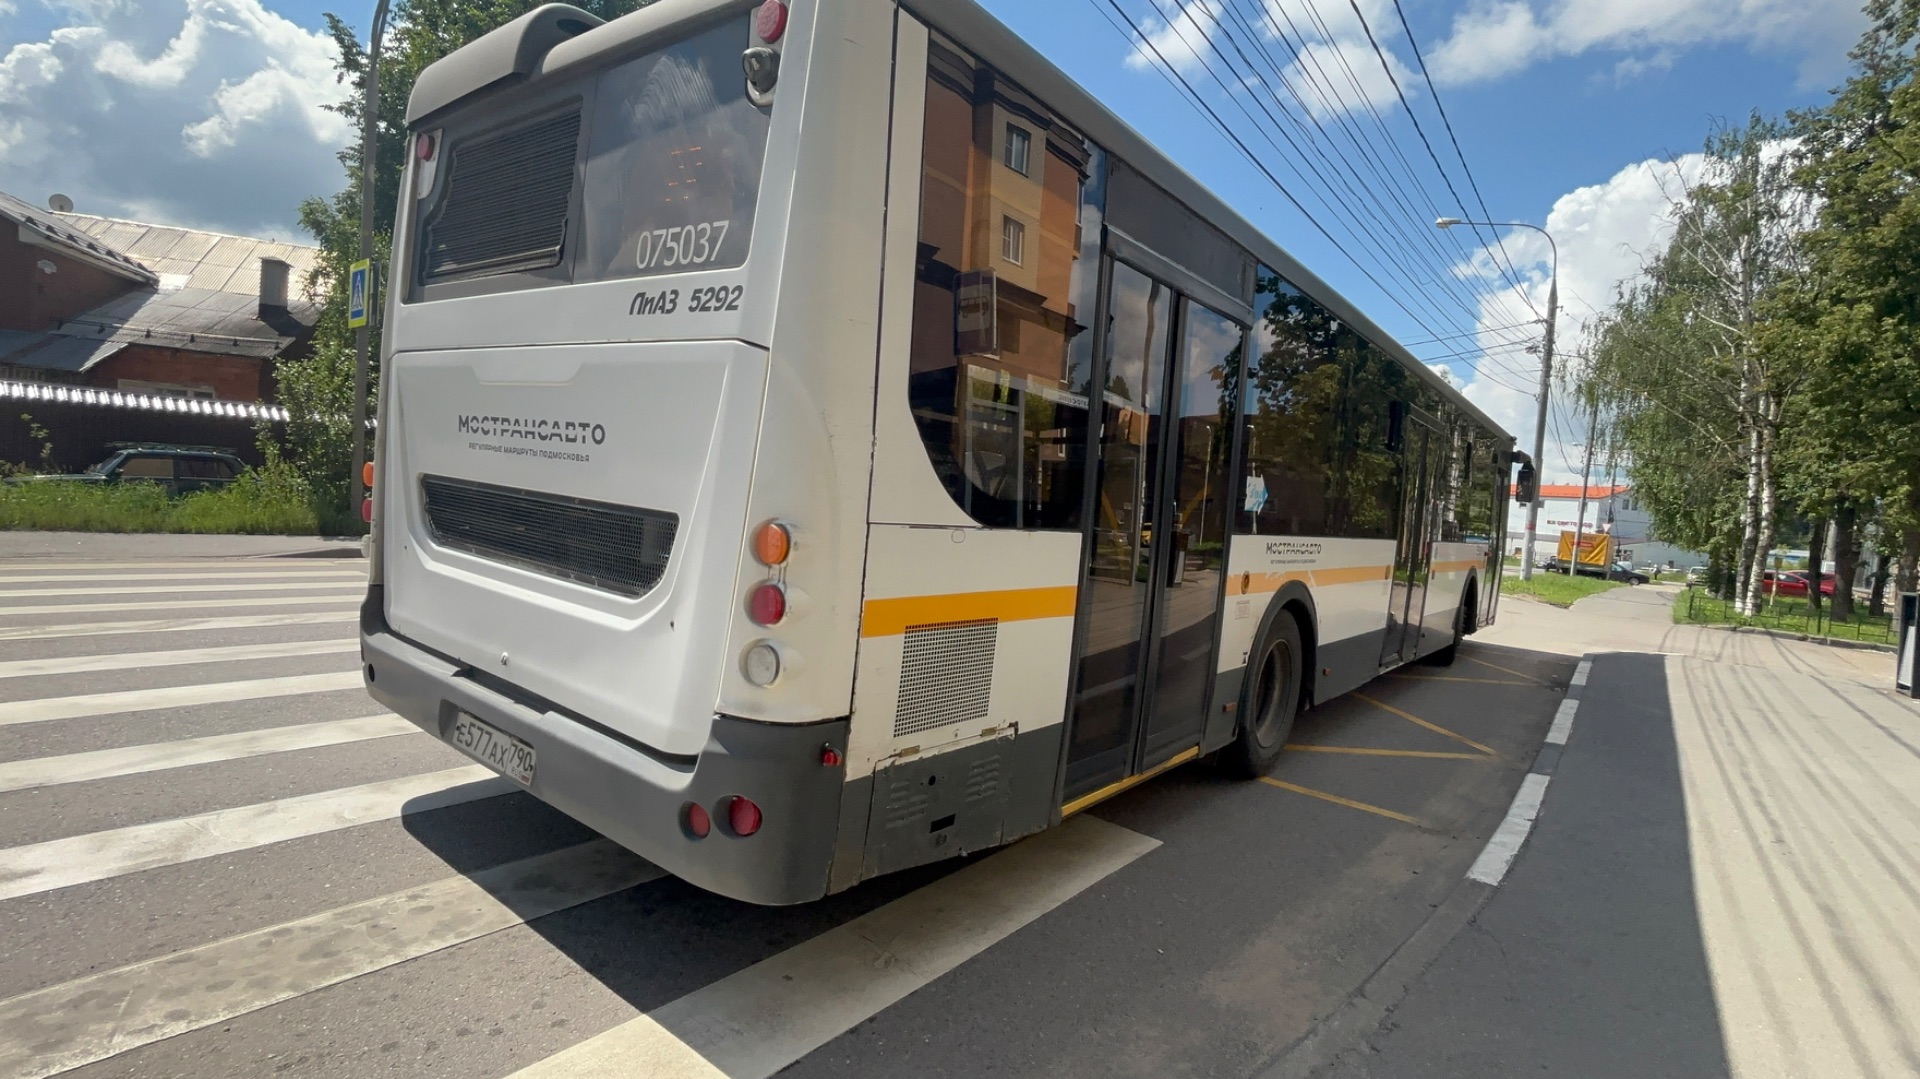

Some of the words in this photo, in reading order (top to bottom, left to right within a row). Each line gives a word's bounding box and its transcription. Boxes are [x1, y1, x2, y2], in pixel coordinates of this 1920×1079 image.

[636, 219, 730, 270] 075037
[688, 284, 744, 313] 5292
[458, 414, 607, 446] МОСТРАНСАВТО
[468, 441, 502, 453] РЕГУЛЯРНЫЕ
[504, 445, 538, 458] МАРШРУТЫ
[539, 449, 591, 463] ПОДМОСКОВЬЯ
[1266, 542, 1322, 555] МОСТРАНСАВТО
